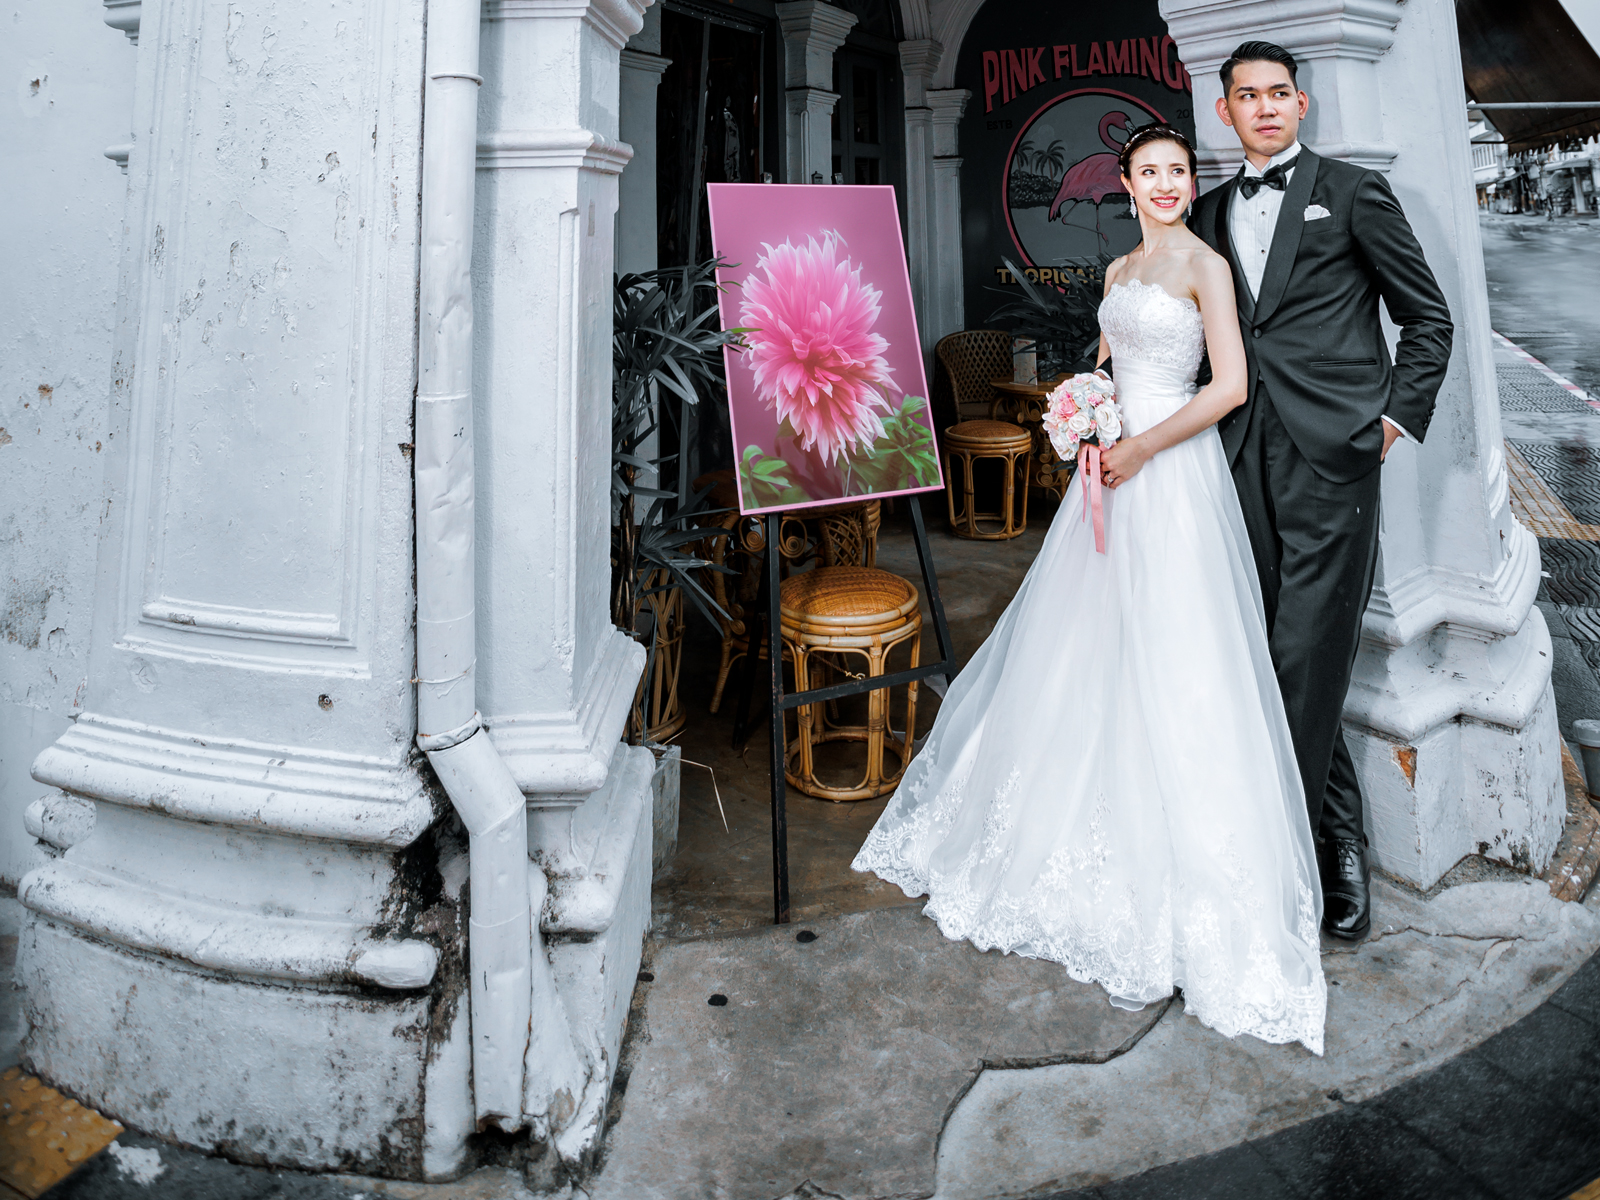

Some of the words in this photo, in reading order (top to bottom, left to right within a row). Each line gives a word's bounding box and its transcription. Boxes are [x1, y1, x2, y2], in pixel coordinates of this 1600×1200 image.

[982, 46, 1046, 113] PINK
[986, 119, 1013, 131] ESTB
[1176, 108, 1194, 119] 201
